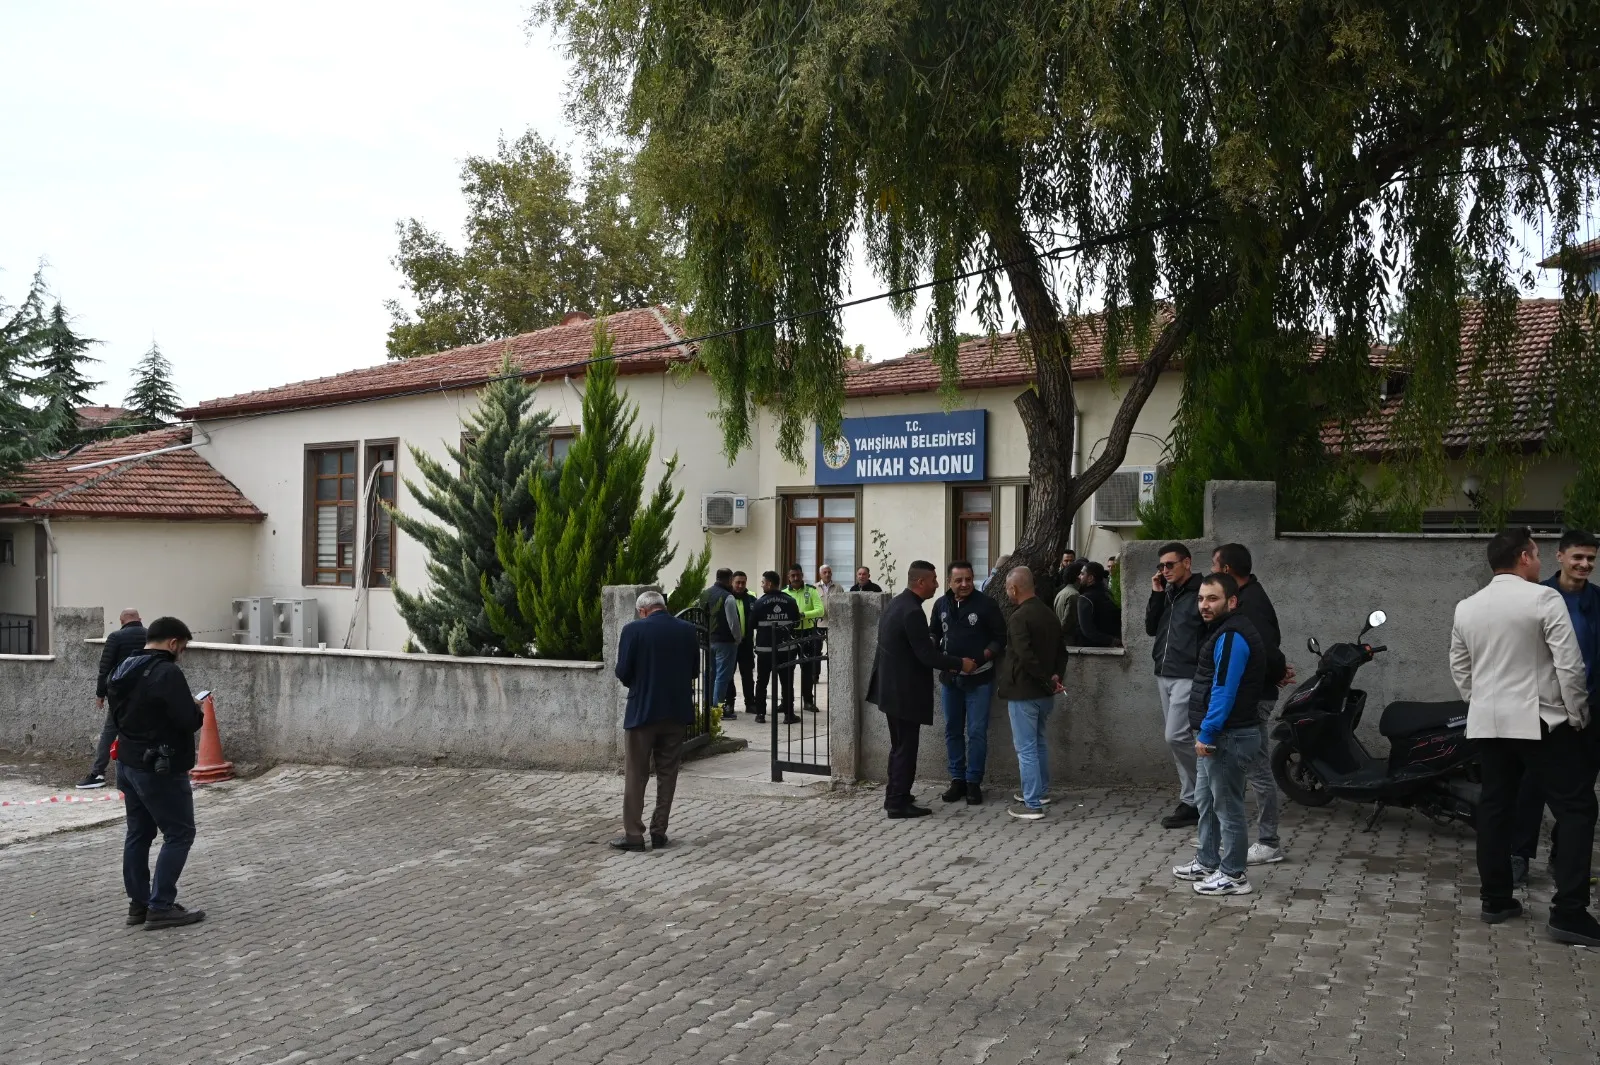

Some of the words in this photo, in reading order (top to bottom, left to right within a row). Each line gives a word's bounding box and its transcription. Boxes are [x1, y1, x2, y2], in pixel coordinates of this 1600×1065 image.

[905, 420, 922, 432] T.C.
[854, 433, 908, 454] YAHŞİHAN
[911, 428, 976, 449] BELEDİYESİ
[856, 454, 904, 478] NİKAH
[909, 454, 974, 477] SALONU
